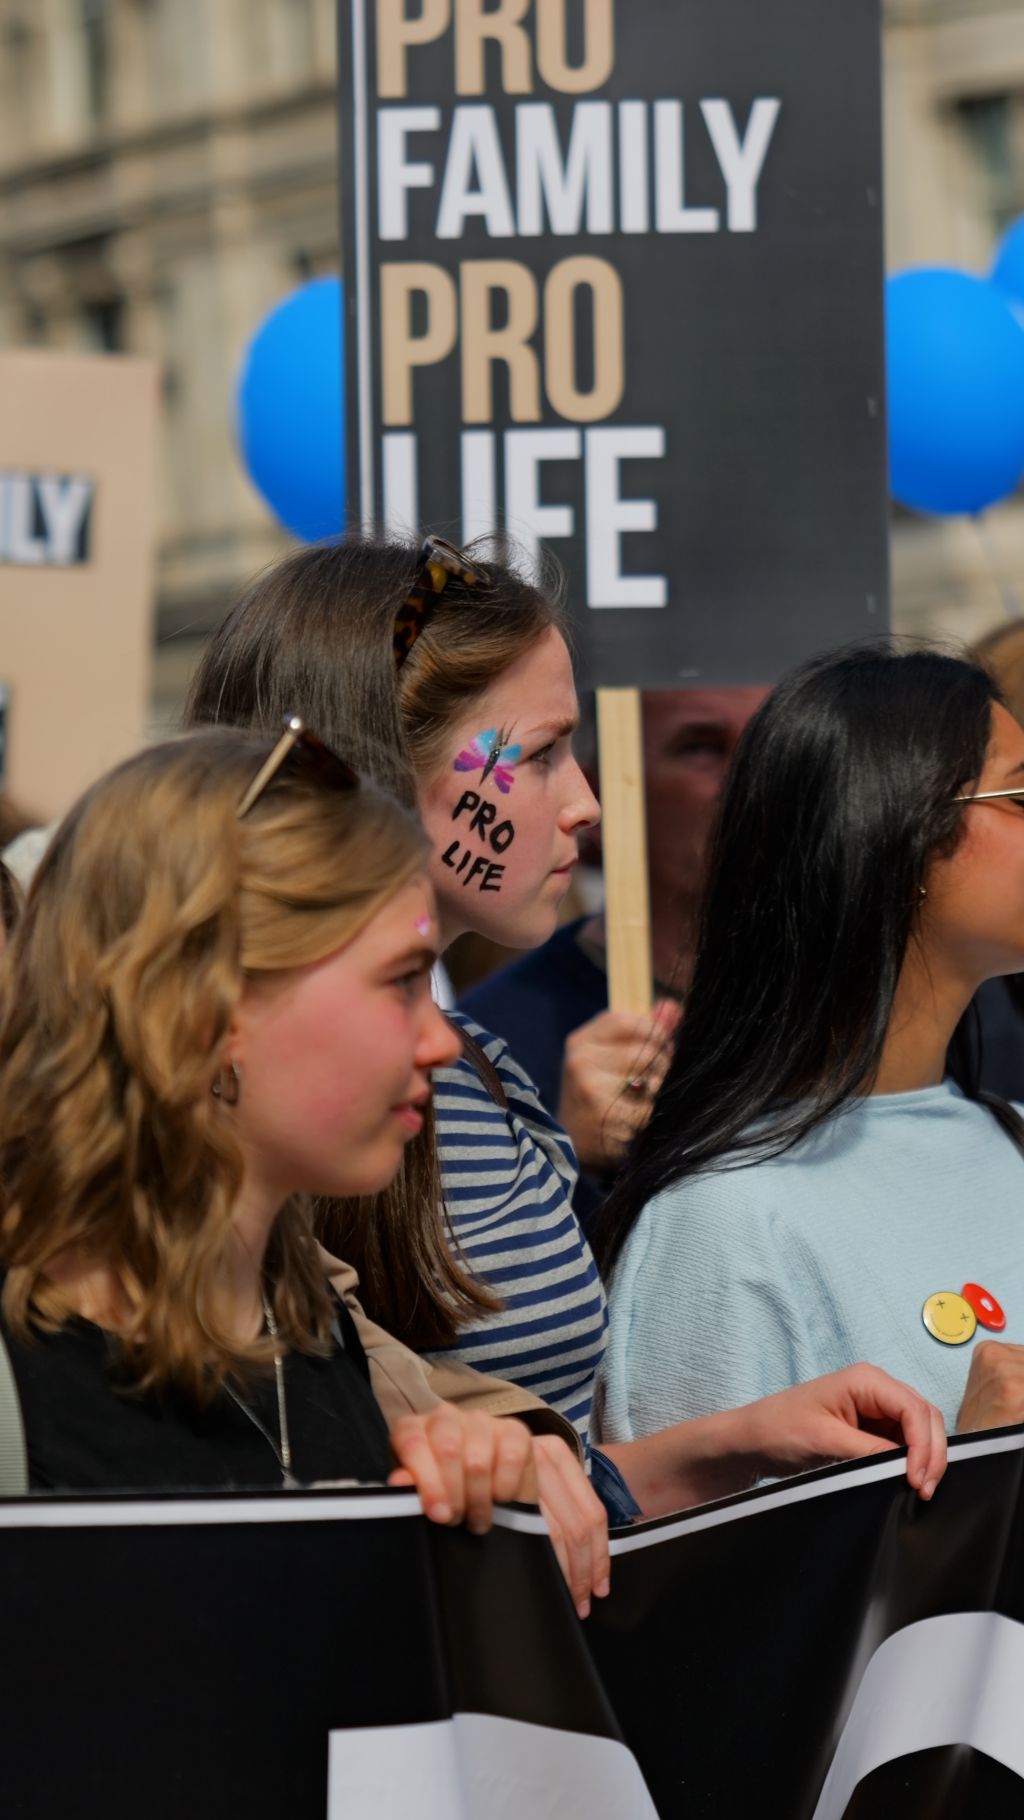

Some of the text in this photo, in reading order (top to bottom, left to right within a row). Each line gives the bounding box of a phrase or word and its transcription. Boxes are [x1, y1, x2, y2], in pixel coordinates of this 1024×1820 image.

[376, 0, 615, 98] PRO
[376, 98, 780, 240] FAMILY
[379, 255, 624, 426] PRO
[442, 840, 506, 892] LIFE
[452, 790, 515, 855] PRO
